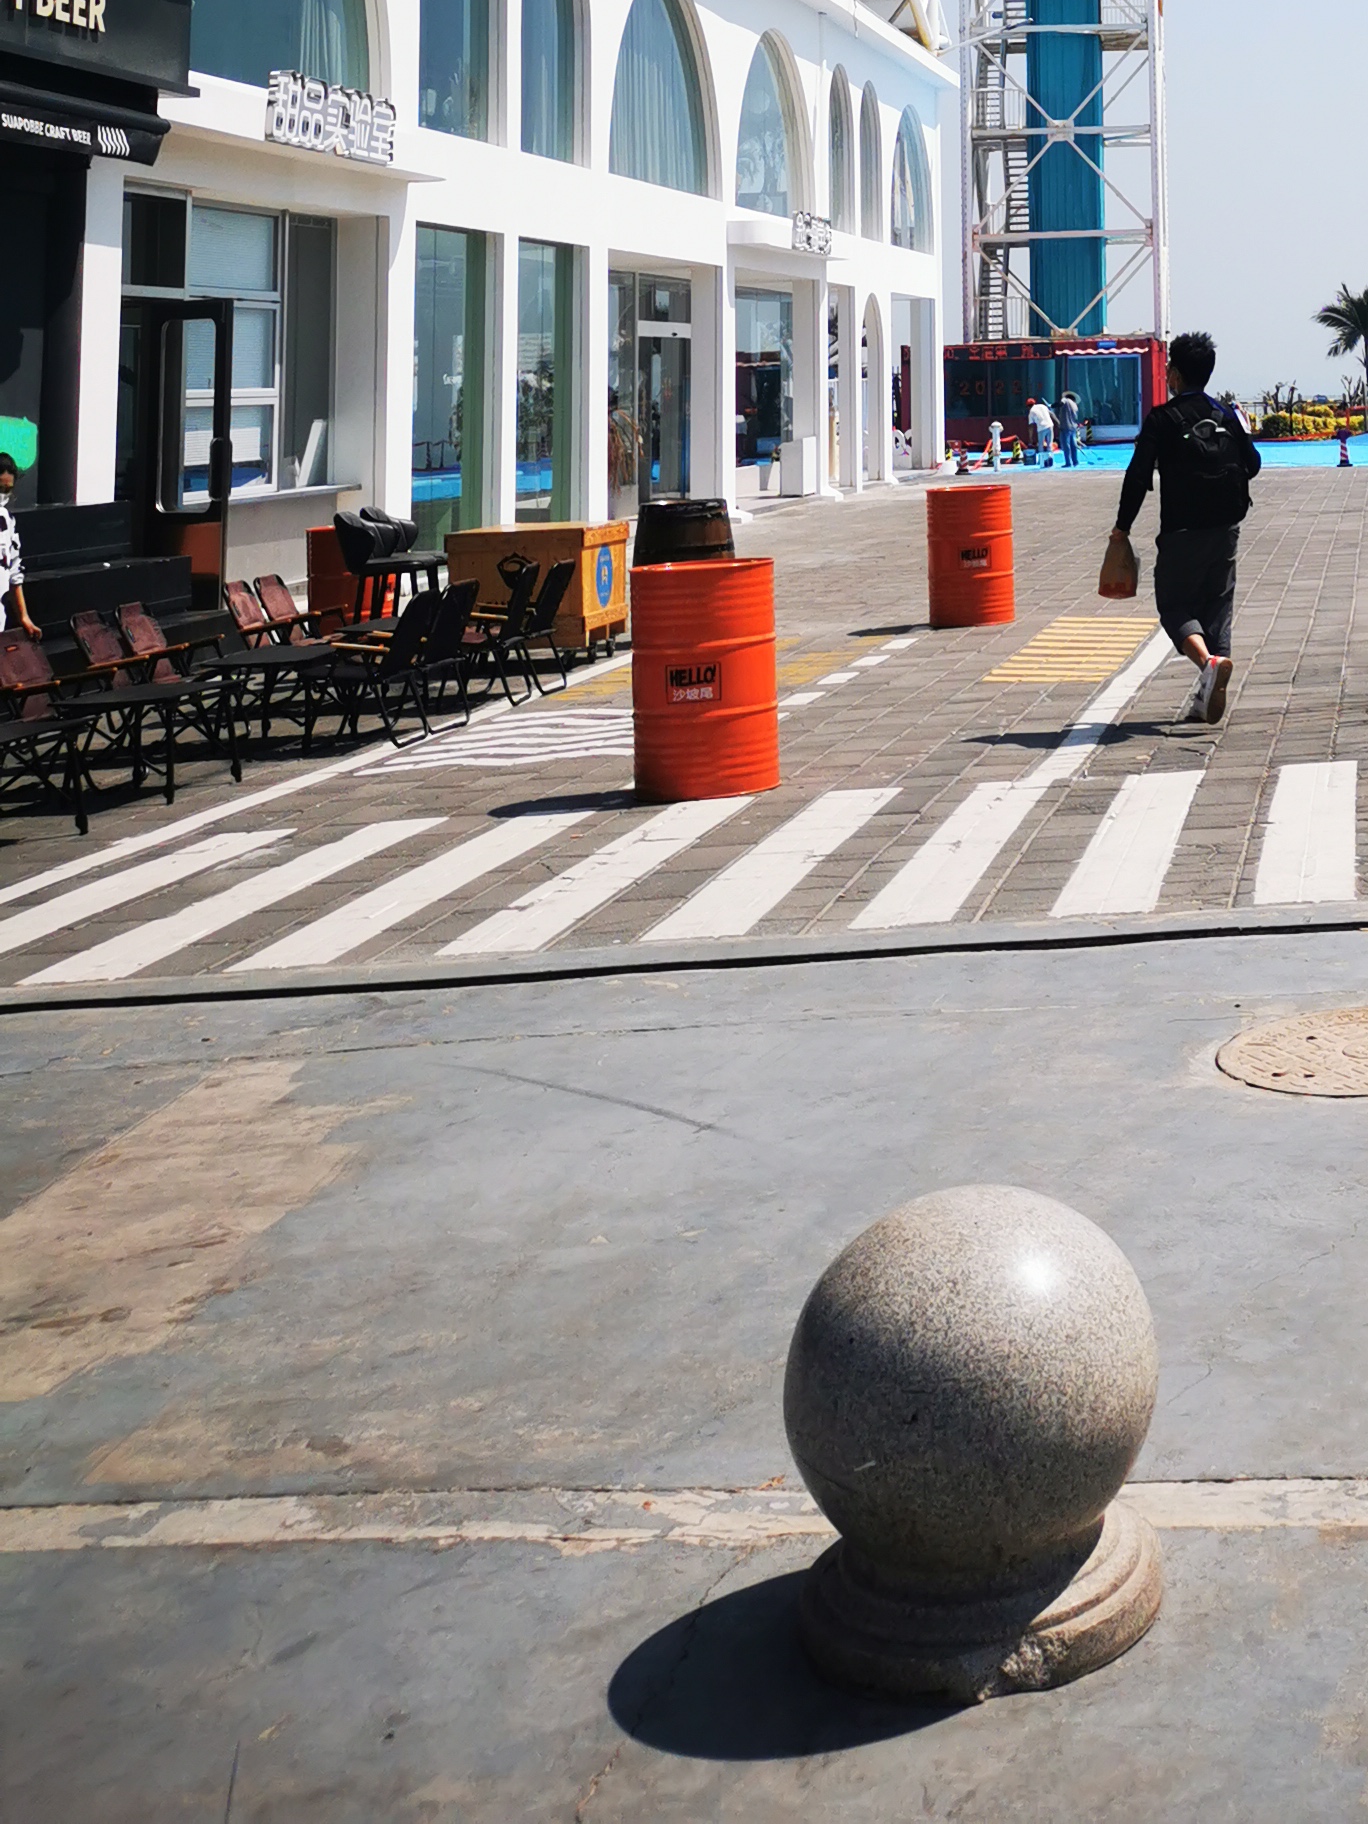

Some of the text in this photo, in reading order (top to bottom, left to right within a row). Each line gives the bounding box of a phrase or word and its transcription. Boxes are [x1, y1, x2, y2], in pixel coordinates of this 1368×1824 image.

[269, 72, 397, 165] 甜品实验室
[45, 124, 72, 141] CRAFT
[72, 131, 92, 146] BEER
[672, 686, 714, 702] 沙坡尾
